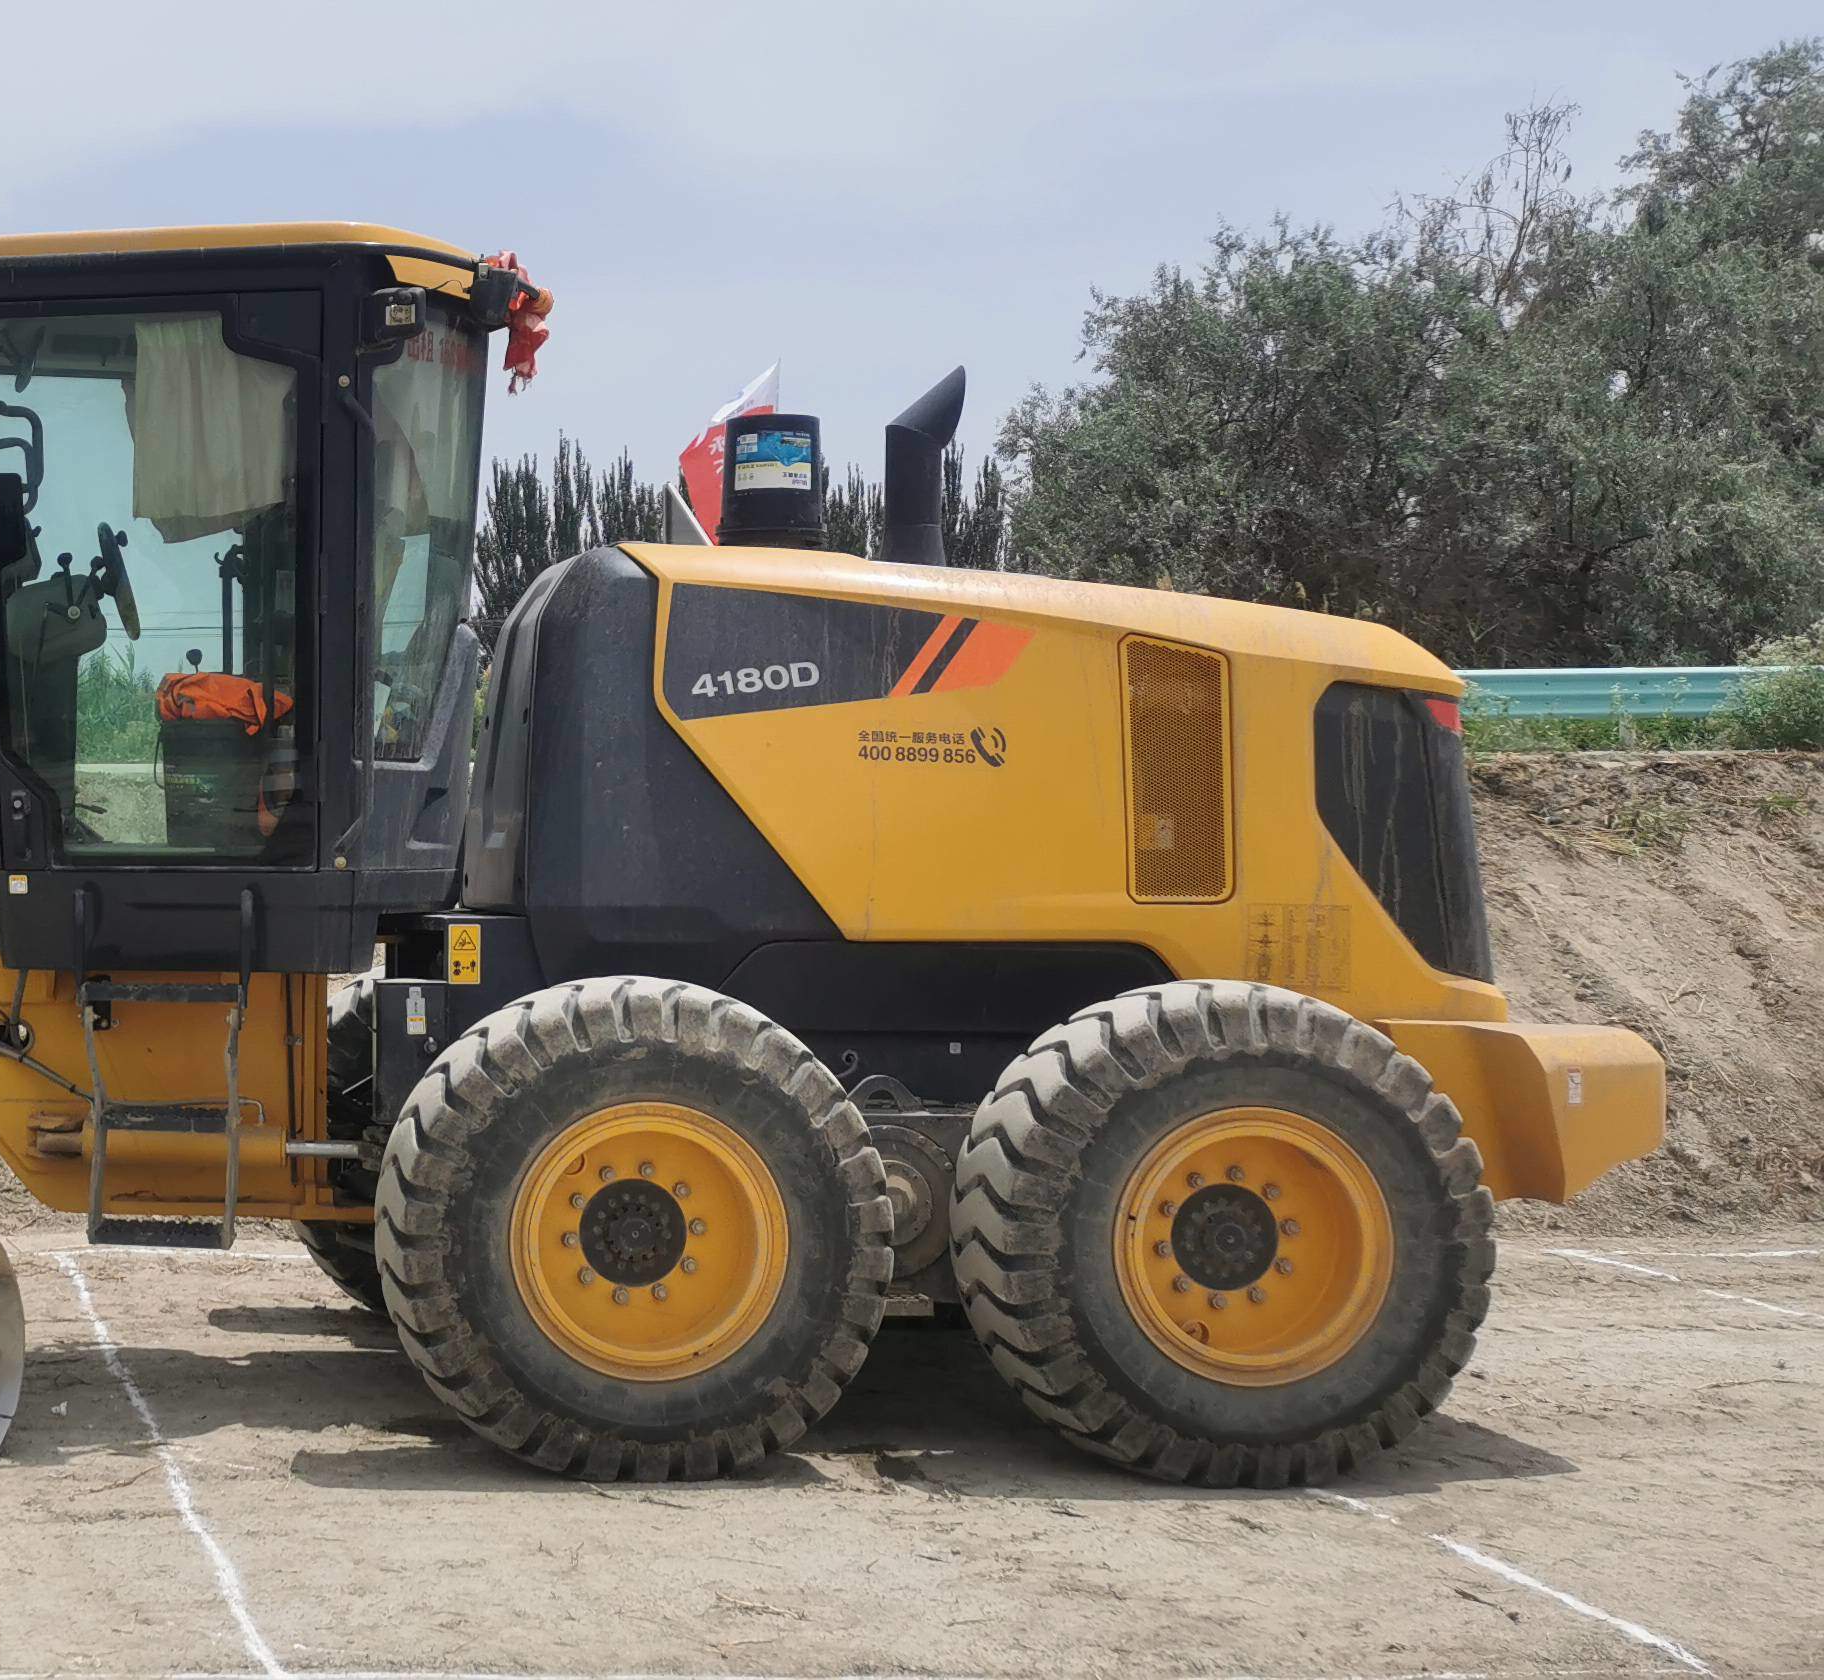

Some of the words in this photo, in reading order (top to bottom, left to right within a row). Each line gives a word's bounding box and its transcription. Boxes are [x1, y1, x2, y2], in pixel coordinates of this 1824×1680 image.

[691, 660, 821, 699] 4180D
[857, 729, 966, 746] 全国统一服务电话
[857, 745, 892, 762] 400
[895, 747, 940, 763] 8899
[943, 749, 977, 764] 856
